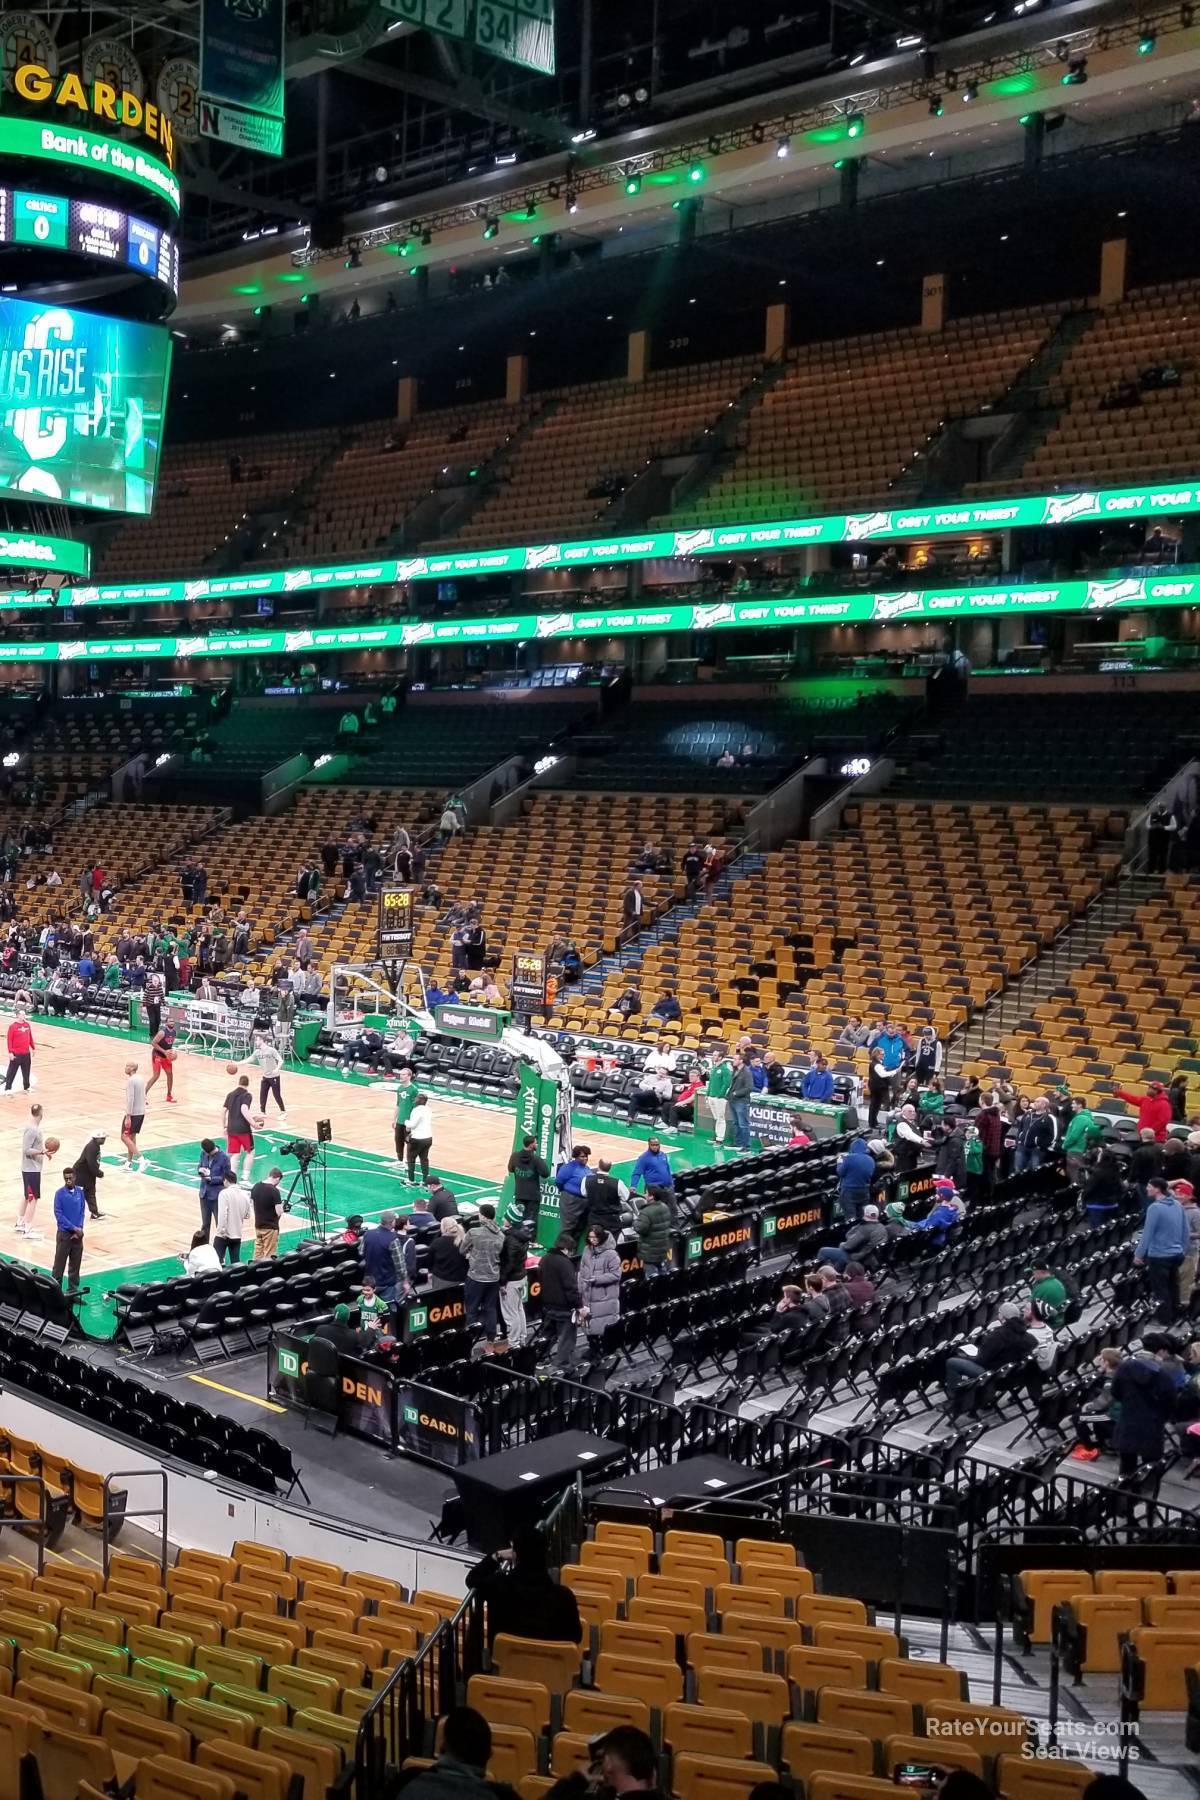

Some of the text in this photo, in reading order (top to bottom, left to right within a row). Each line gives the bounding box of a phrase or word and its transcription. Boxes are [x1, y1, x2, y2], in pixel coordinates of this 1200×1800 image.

[479, 6, 510, 49] 34
[18, 45, 31, 64] 4
[15, 63, 173, 149] GARDEN
[180, 90, 192, 112] 2
[41, 128, 88, 158] Bank
[91, 142, 109, 162] of
[110, 147, 134, 172] the
[26, 199, 59, 214] CELTICS
[34, 215, 50, 240] 0
[139, 241, 150, 266] 0
[0, 346, 88, 401] US RISE
[1106, 490, 1193, 510] OBEY YOUR
[897, 507, 1019, 528] OBEY YOUR THIRST
[718, 525, 823, 545] OBEY YOUR THIRST
[564, 541, 655, 559] OBEY YOUR THIRST
[430, 555, 509, 572] OBEY YOUR THIRST
[929, 590, 1060, 608] OBEY YOUR THIRST
[1151, 583, 1194, 597] OBEY
[576, 613, 673, 628] OBEY YOUR THIRST
[739, 603, 851, 619] OBEY YOUR THIRST
[437, 622, 520, 637] OBEY YOUR THIRST
[852, 758, 871, 775] 10
[384, 892, 410, 908] 65:28
[388, 932, 412, 942] TISSOT
[517, 957, 542, 971] 65:28
[384, 1017, 411, 1029] xfinity
[521, 1086, 538, 1138] xfinity
[750, 1106, 791, 1124] KYOCER
[540, 1116, 552, 1160] Putnam
[910, 1178, 935, 1195] GAR
[765, 1208, 821, 1234] TD GARDEN
[690, 1228, 752, 1254] TD GARDEN
[411, 1301, 465, 1328] TD GAR
[283, 1353, 298, 1373] TD
[404, 1406, 418, 1423] TD
